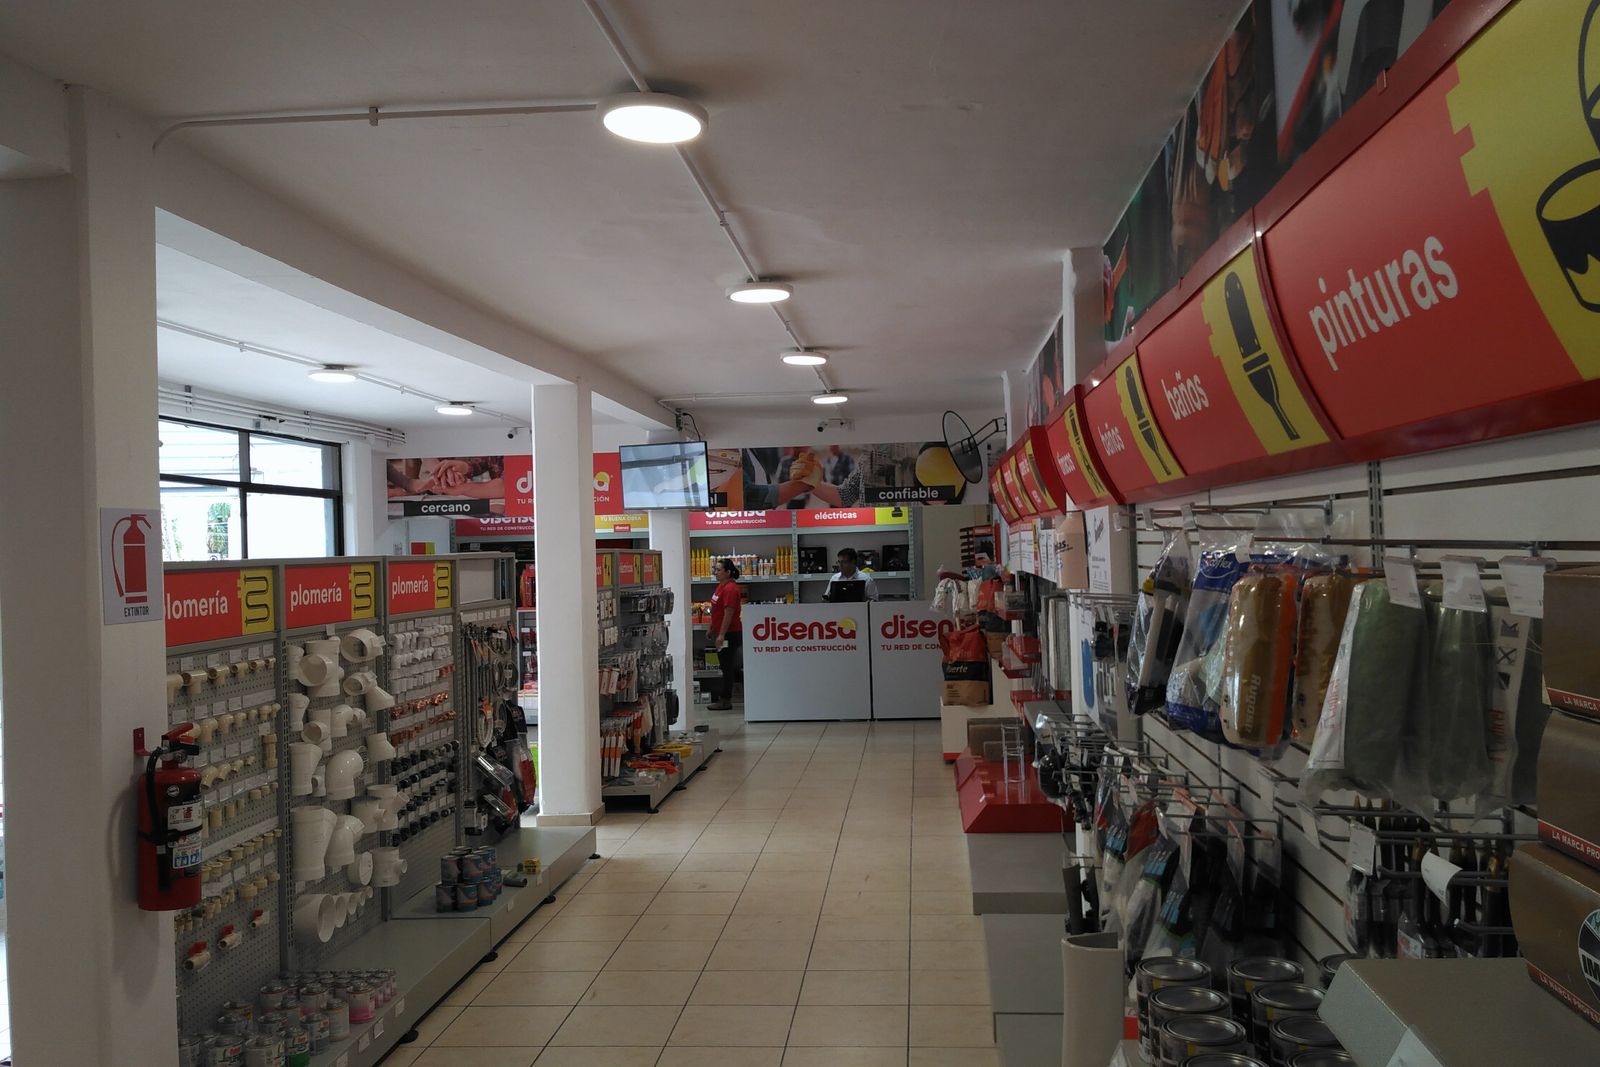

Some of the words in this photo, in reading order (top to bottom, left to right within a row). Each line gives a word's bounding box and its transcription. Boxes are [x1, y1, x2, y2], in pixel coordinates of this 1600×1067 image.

[1308, 235, 1459, 372] pinturas
[1160, 370, 1210, 421] baños
[878, 487, 939, 500] confiable
[420, 503, 471, 514] cercano
[814, 511, 857, 521] eléctricas
[290, 582, 342, 612] plomería
[392, 575, 429, 599] plomería
[164, 578, 229, 620] lomería
[124, 605, 149, 618] EXTINTOR
[752, 616, 857, 641] disensa
[795, 643, 857, 652] CONSTRUCCIÓN
[1562, 695, 1573, 705] LA
[1573, 697, 1599, 712] MARCA
[1551, 830, 1561, 841] LA
[1561, 834, 1585, 853] MARCA
